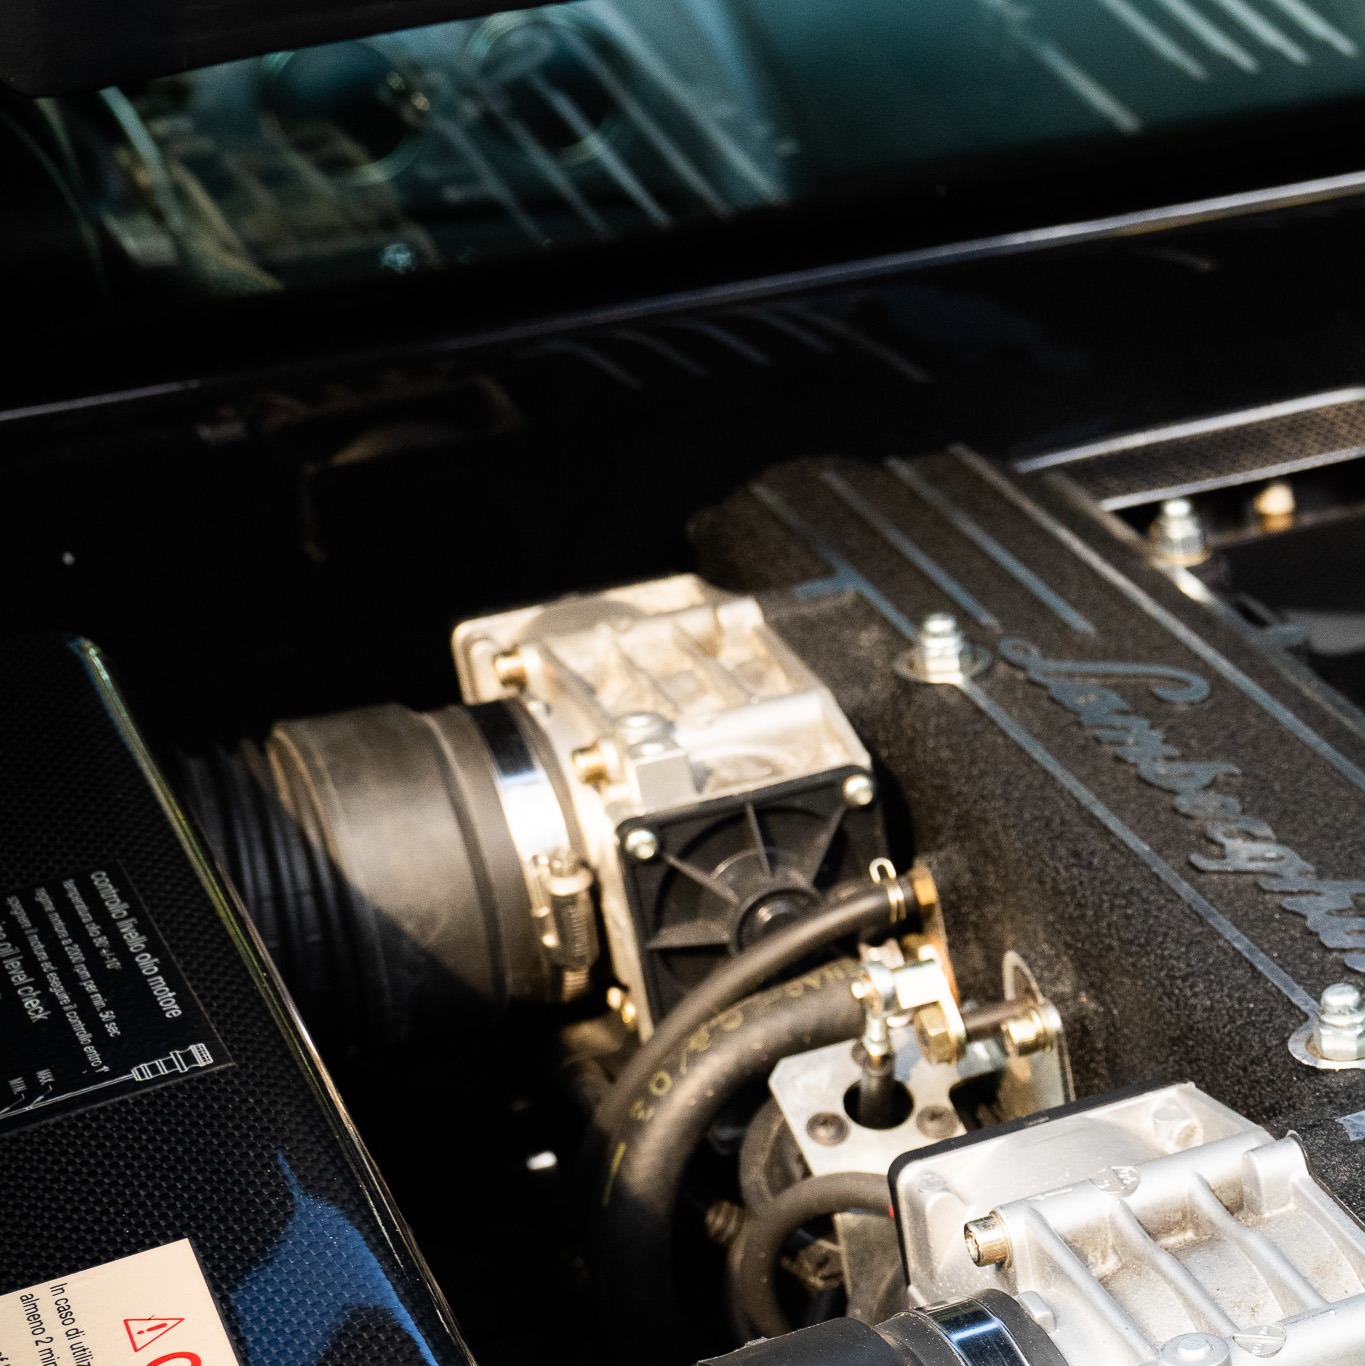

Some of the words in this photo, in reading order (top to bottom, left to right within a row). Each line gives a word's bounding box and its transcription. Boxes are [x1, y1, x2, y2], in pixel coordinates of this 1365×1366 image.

[91, 871, 128, 918] controllo
[117, 918, 146, 952] livello
[135, 952, 159, 975] olio
[147, 975, 181, 1017] motore
[3, 956, 34, 985] level
[17, 986, 50, 1022] check
[99, 1010, 115, 1021] 50
[65, 1011, 92, 1044] controllo
[83, 1045, 102, 1066] entro
[104, 1022, 120, 1036] sec
[48, 1281, 68, 1297] In
[18, 1292, 46, 1336] almeno
[33, 1335, 54, 1347] 2
[53, 1296, 76, 1326] caso
[64, 1327, 86, 1341] di
